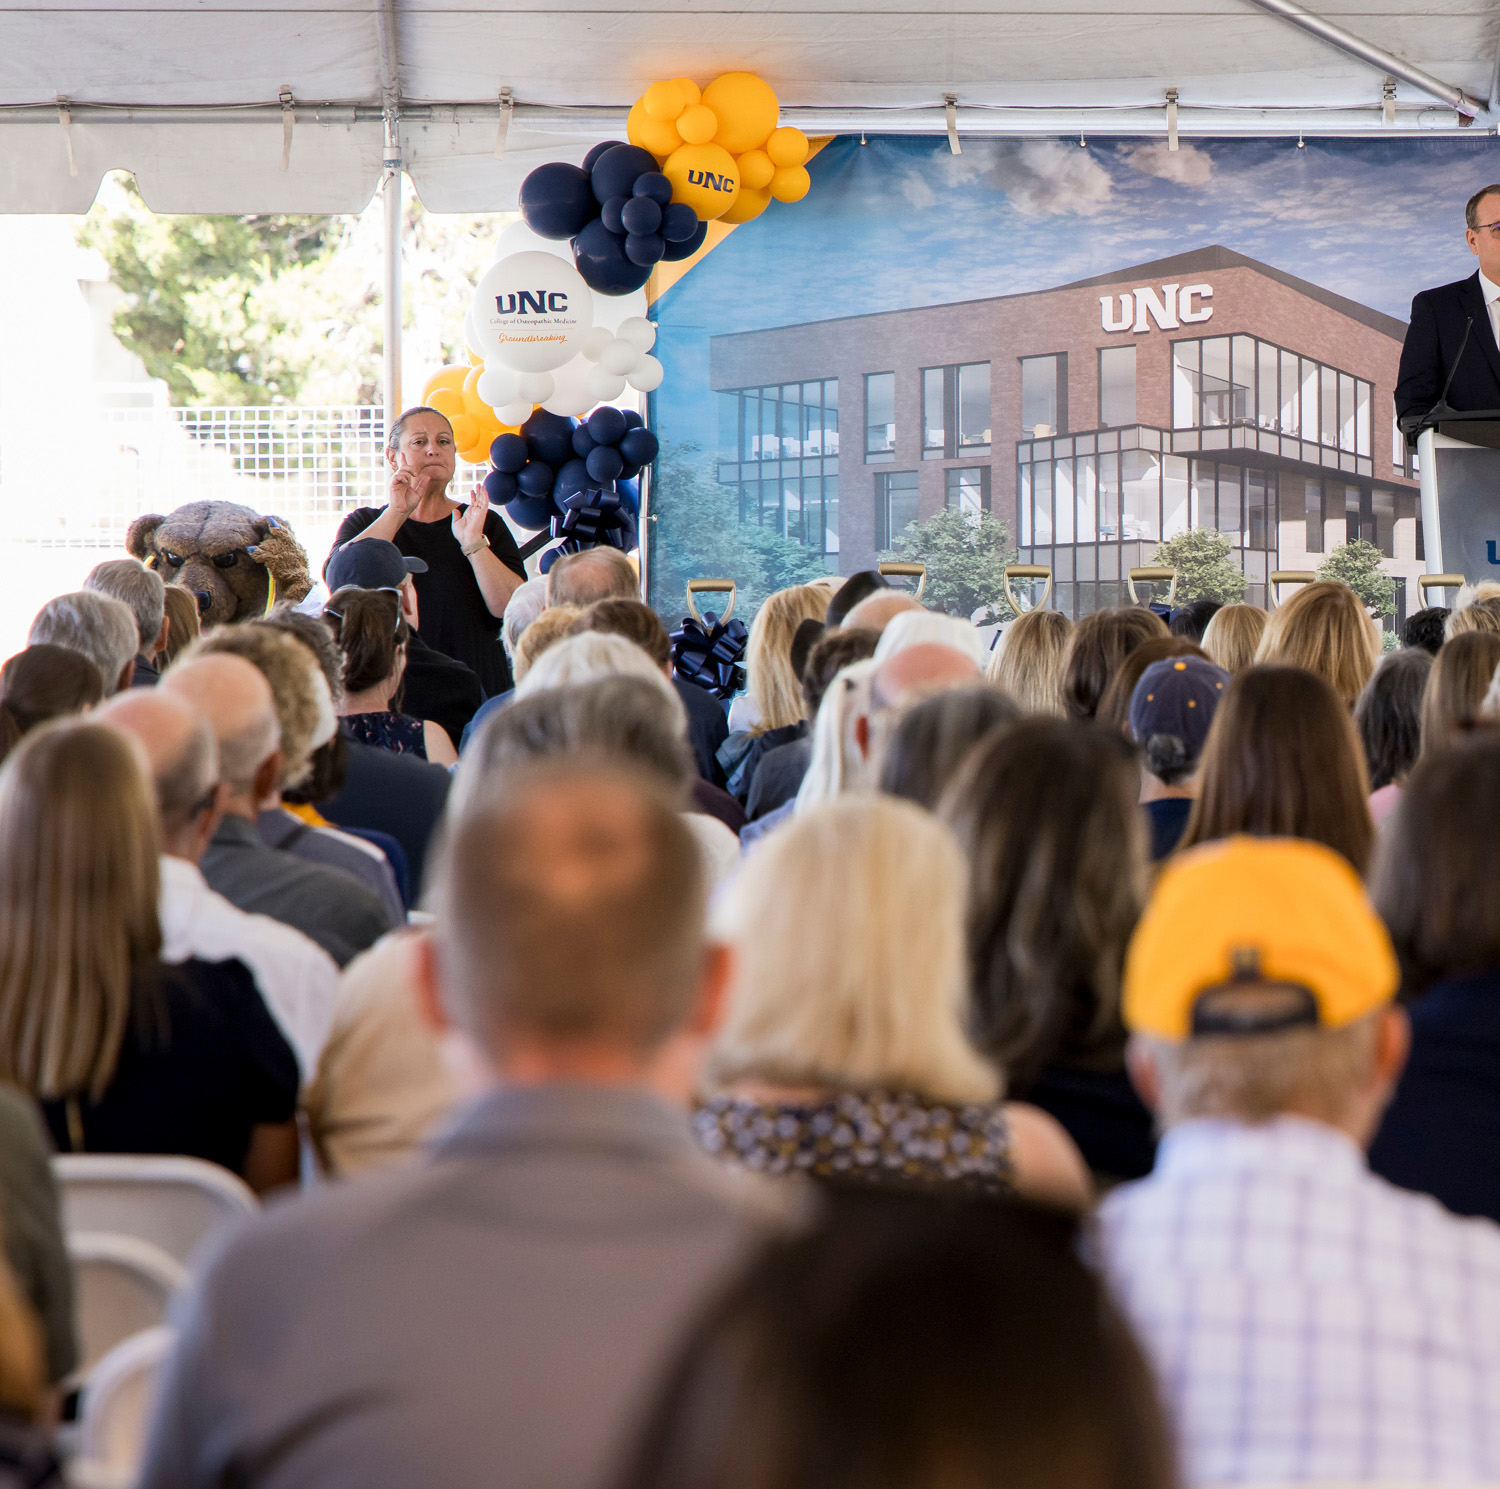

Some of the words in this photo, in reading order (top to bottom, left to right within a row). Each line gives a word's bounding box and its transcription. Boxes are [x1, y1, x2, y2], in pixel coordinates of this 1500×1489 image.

[688, 169, 735, 193] UNC
[495, 290, 568, 315] UNC
[1100, 283, 1213, 334] UNC
[498, 332, 568, 344] Groundbreaking
